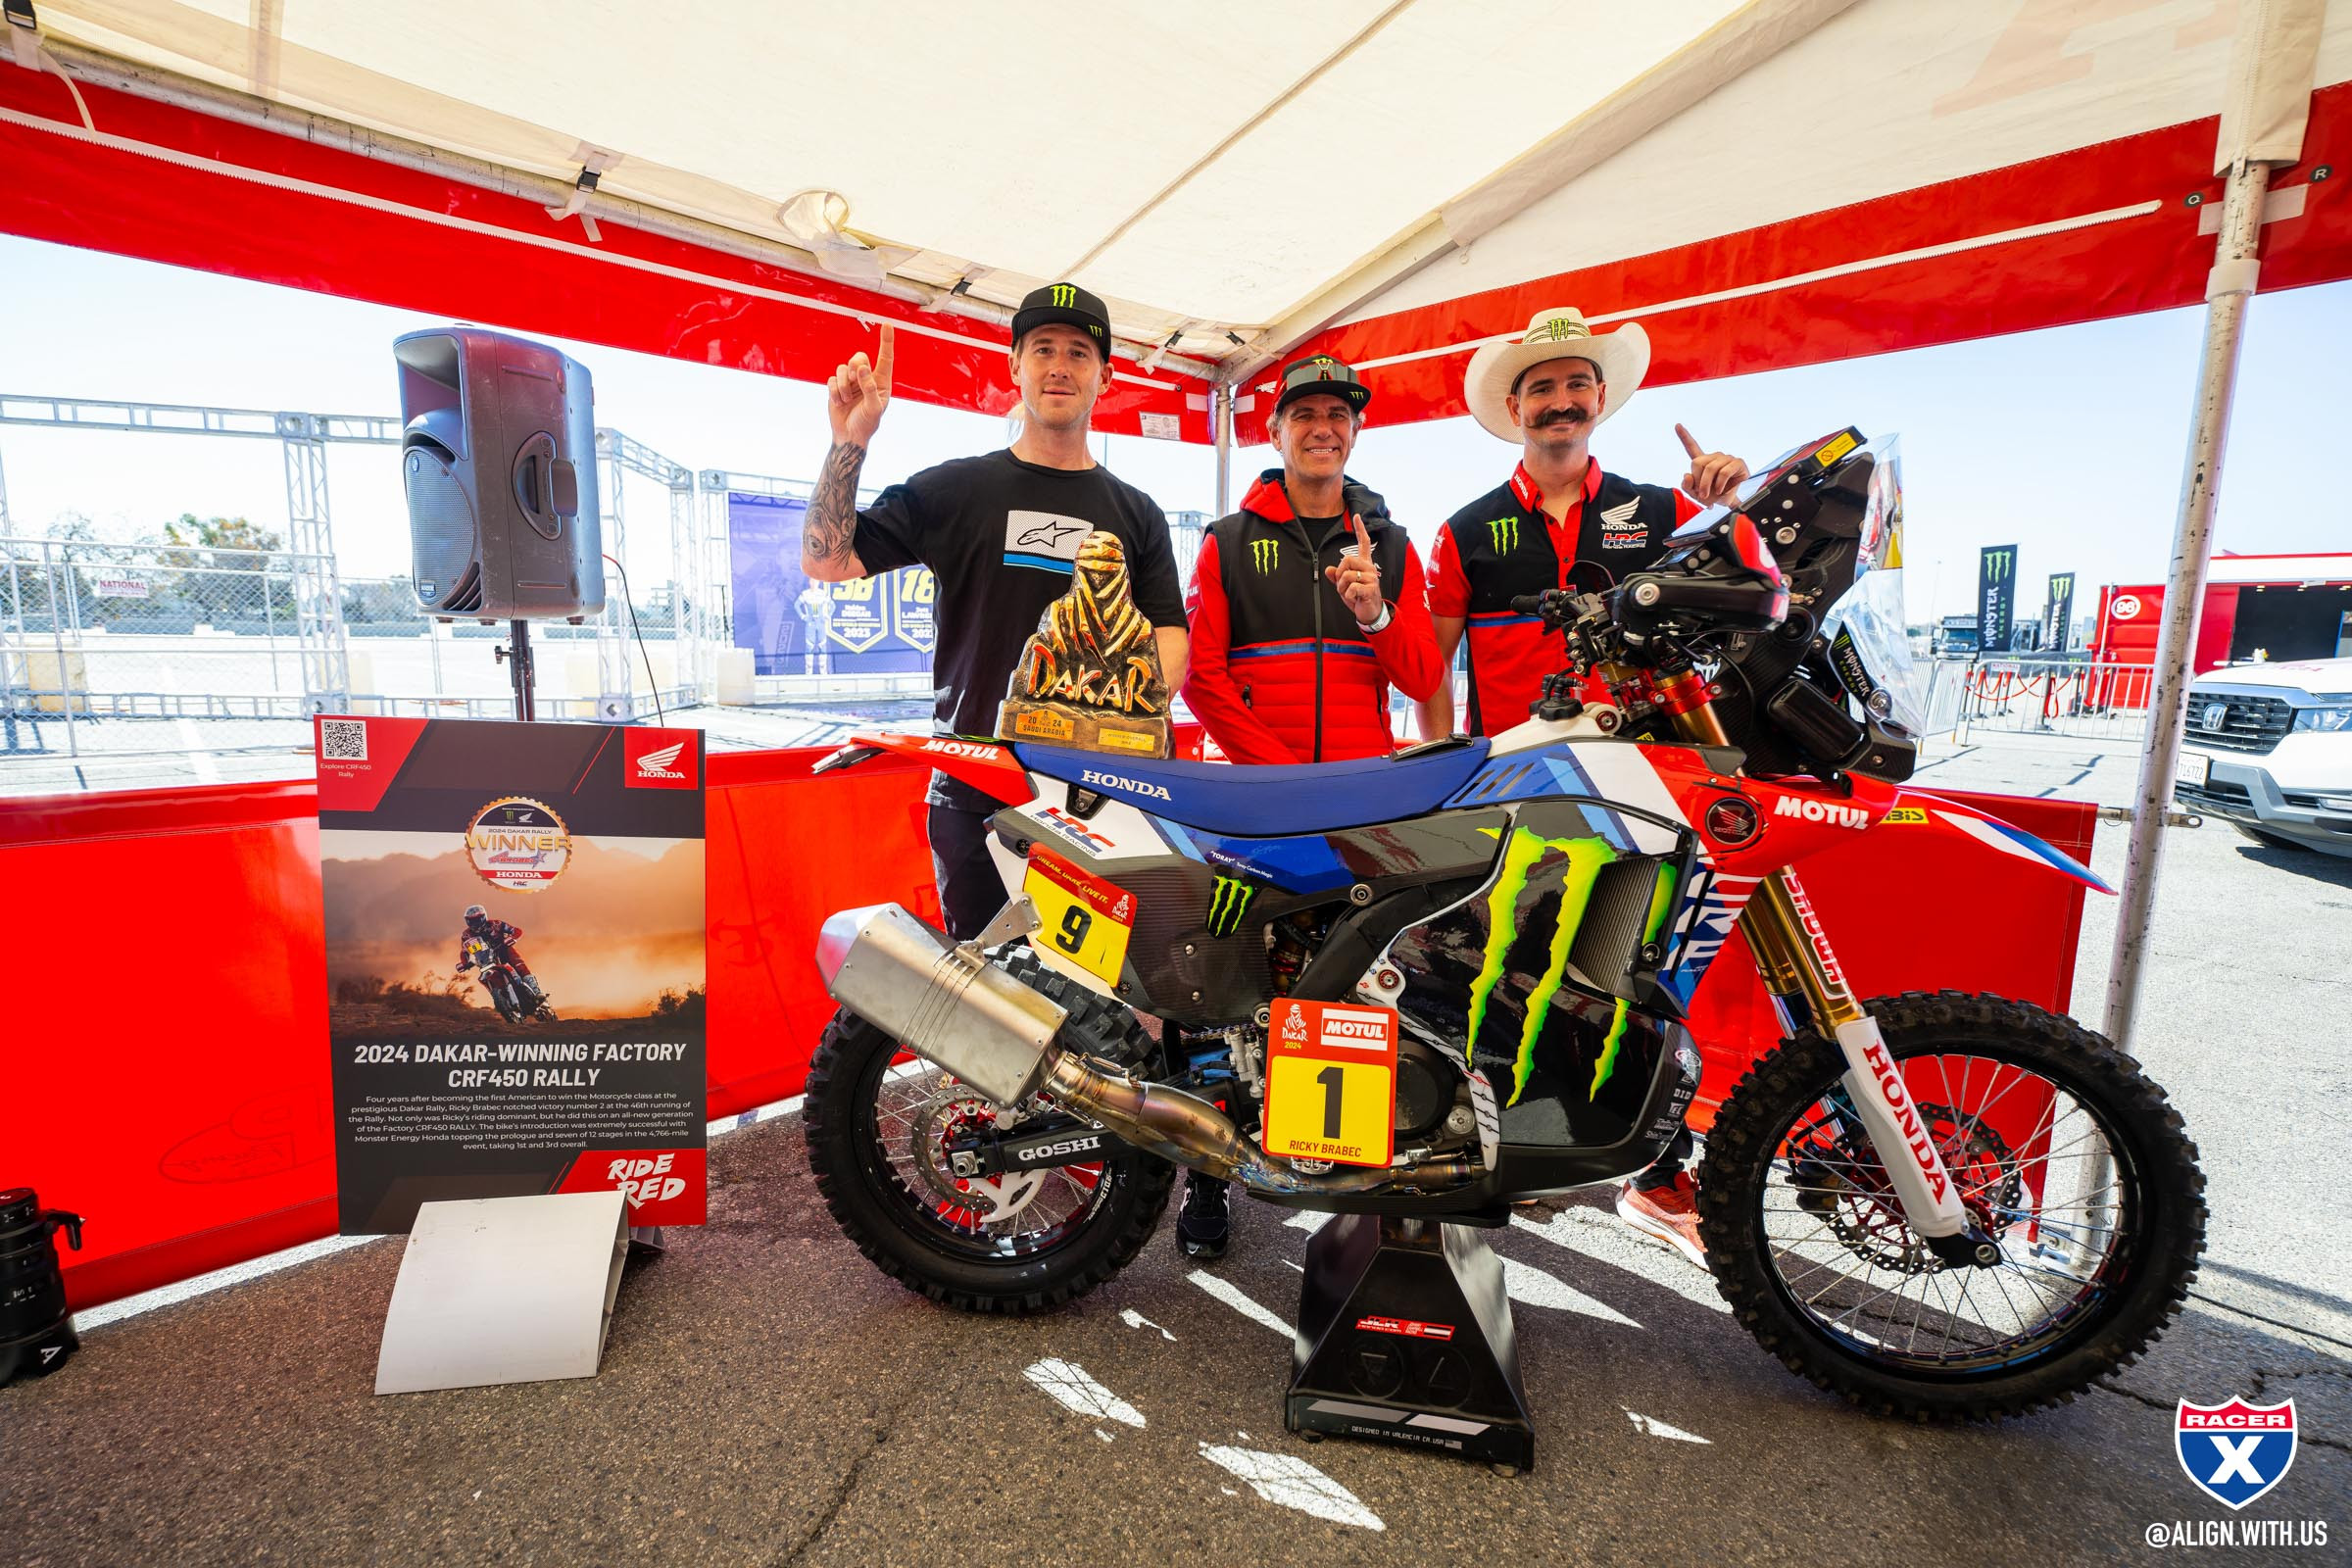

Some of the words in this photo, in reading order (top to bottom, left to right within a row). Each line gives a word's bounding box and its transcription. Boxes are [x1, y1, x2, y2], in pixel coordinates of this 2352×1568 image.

[2315, 169, 2327, 179] R
[1514, 473, 1529, 501] HONDA
[1601, 522, 1648, 531] HONDA
[1602, 531, 1649, 546] HRC
[100, 580, 146, 590] NATIONAL
[1984, 586, 2000, 648] MONSTER
[1026, 642, 1156, 714] DAKAR
[1842, 646, 1871, 697] MONSTER
[1028, 715, 1037, 724] 20
[1053, 719, 1062, 728] 24
[919, 740, 1000, 760] MOTUL
[319, 763, 345, 772] Explore
[637, 770, 686, 779] HONDA
[1081, 769, 1172, 802] HONDA
[1774, 795, 1870, 830] MOTUL
[1034, 807, 1116, 854] HRC
[465, 834, 573, 851] WINNER
[1082, 884, 1101, 900] LIVE
[1098, 895, 1109, 905] IT.
[1055, 905, 1093, 955] 9
[1282, 1026, 1308, 1042] DAKAR
[1324, 1020, 1385, 1039] MOTUL
[355, 1045, 409, 1064] 2024
[415, 1043, 588, 1063] DAKAR-WINNING
[593, 1043, 687, 1061] FACTORY
[1284, 1041, 1302, 1051] 2024
[448, 1068, 528, 1088] CRF450
[533, 1068, 601, 1087] RALLY
[431, 1095, 473, 1103] becoming
[589, 1093, 633, 1102] Motorcycle
[1316, 1065, 1344, 1140] 1
[351, 1105, 398, 1114] prestigious
[425, 1104, 448, 1113] Rally,
[449, 1104, 471, 1113] Ricky
[538, 1103, 564, 1112] victory
[650, 1102, 682, 1110] running
[365, 1116, 387, 1124] Rally.
[405, 1115, 423, 1123] only
[471, 1114, 495, 1122] riding
[497, 1113, 539, 1121] dominant,
[651, 1111, 693, 1120] generation
[383, 1125, 414, 1134] Factory
[588, 1121, 627, 1130] extremely
[1862, 1038, 1946, 1205] HONDA
[391, 1135, 420, 1143] Energy
[451, 1133, 484, 1142] topping
[500, 1132, 537, 1141] prologue
[598, 1130, 624, 1139] stages
[649, 1129, 689, 1138] 4,766-mile
[463, 1142, 488, 1151] event,
[490, 1142, 515, 1151] taking
[1018, 1136, 1102, 1161] GOSHI
[1289, 1140, 1319, 1153] RICKY
[1320, 1143, 1362, 1158] BRABEC
[608, 1152, 675, 1182] RIDE
[616, 1177, 686, 1210] RED
